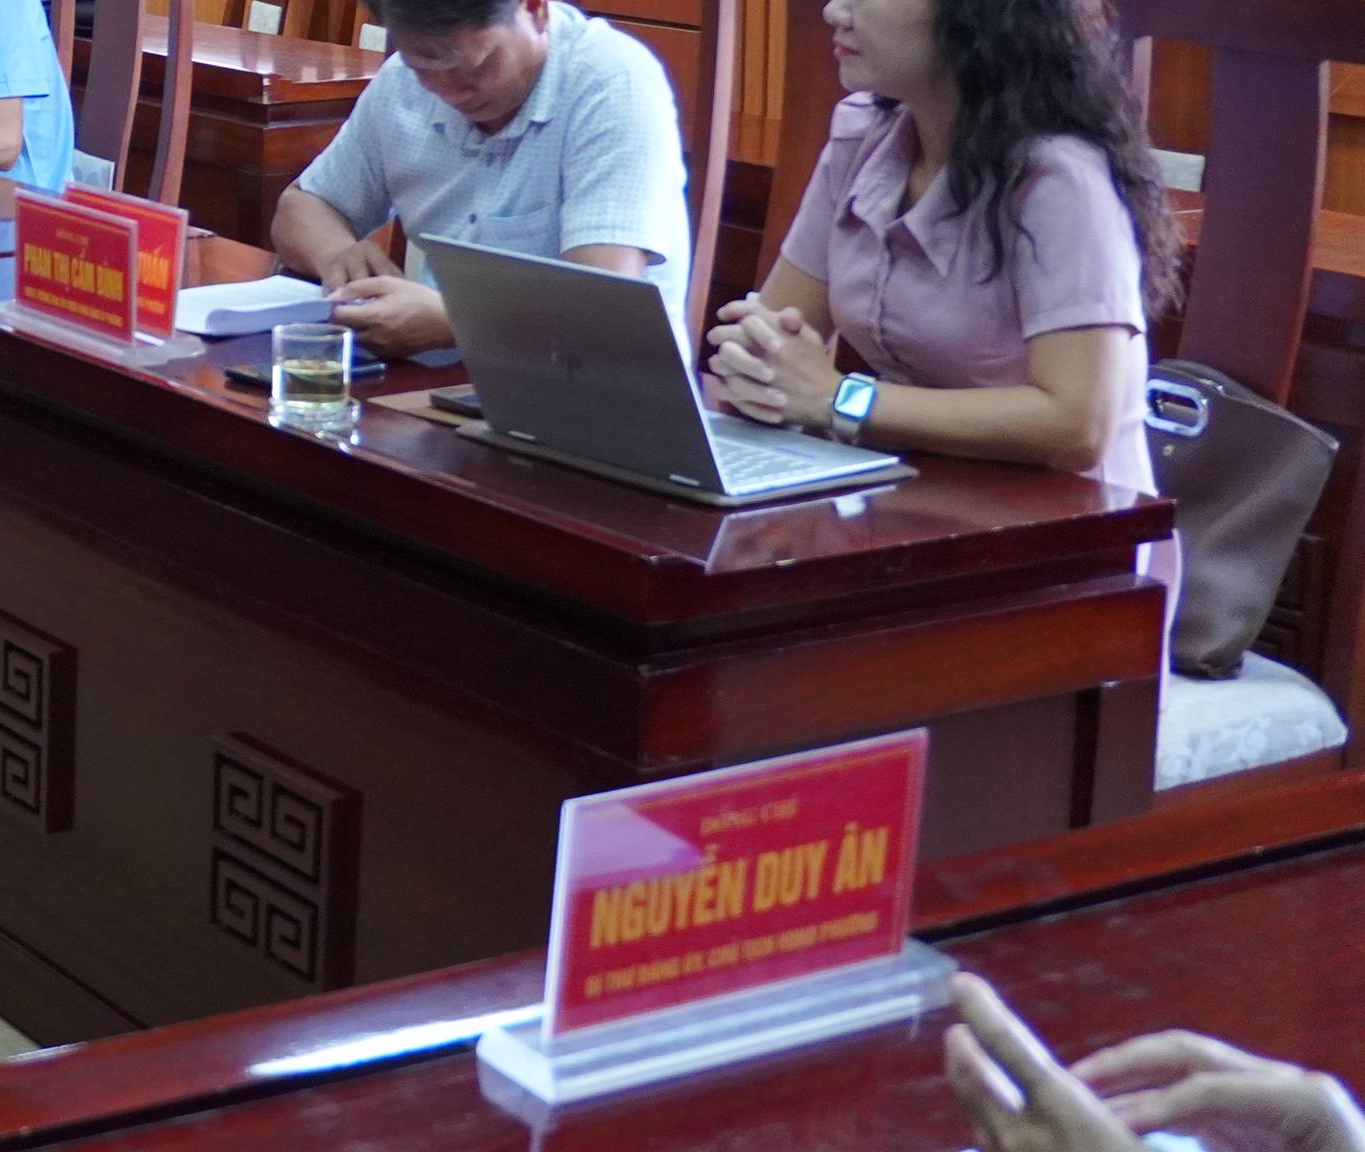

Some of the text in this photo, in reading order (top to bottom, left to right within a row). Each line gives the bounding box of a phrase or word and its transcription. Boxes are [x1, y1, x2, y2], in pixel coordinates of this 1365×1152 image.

[591, 819, 891, 948] NGUYỄN DUY ÂN
